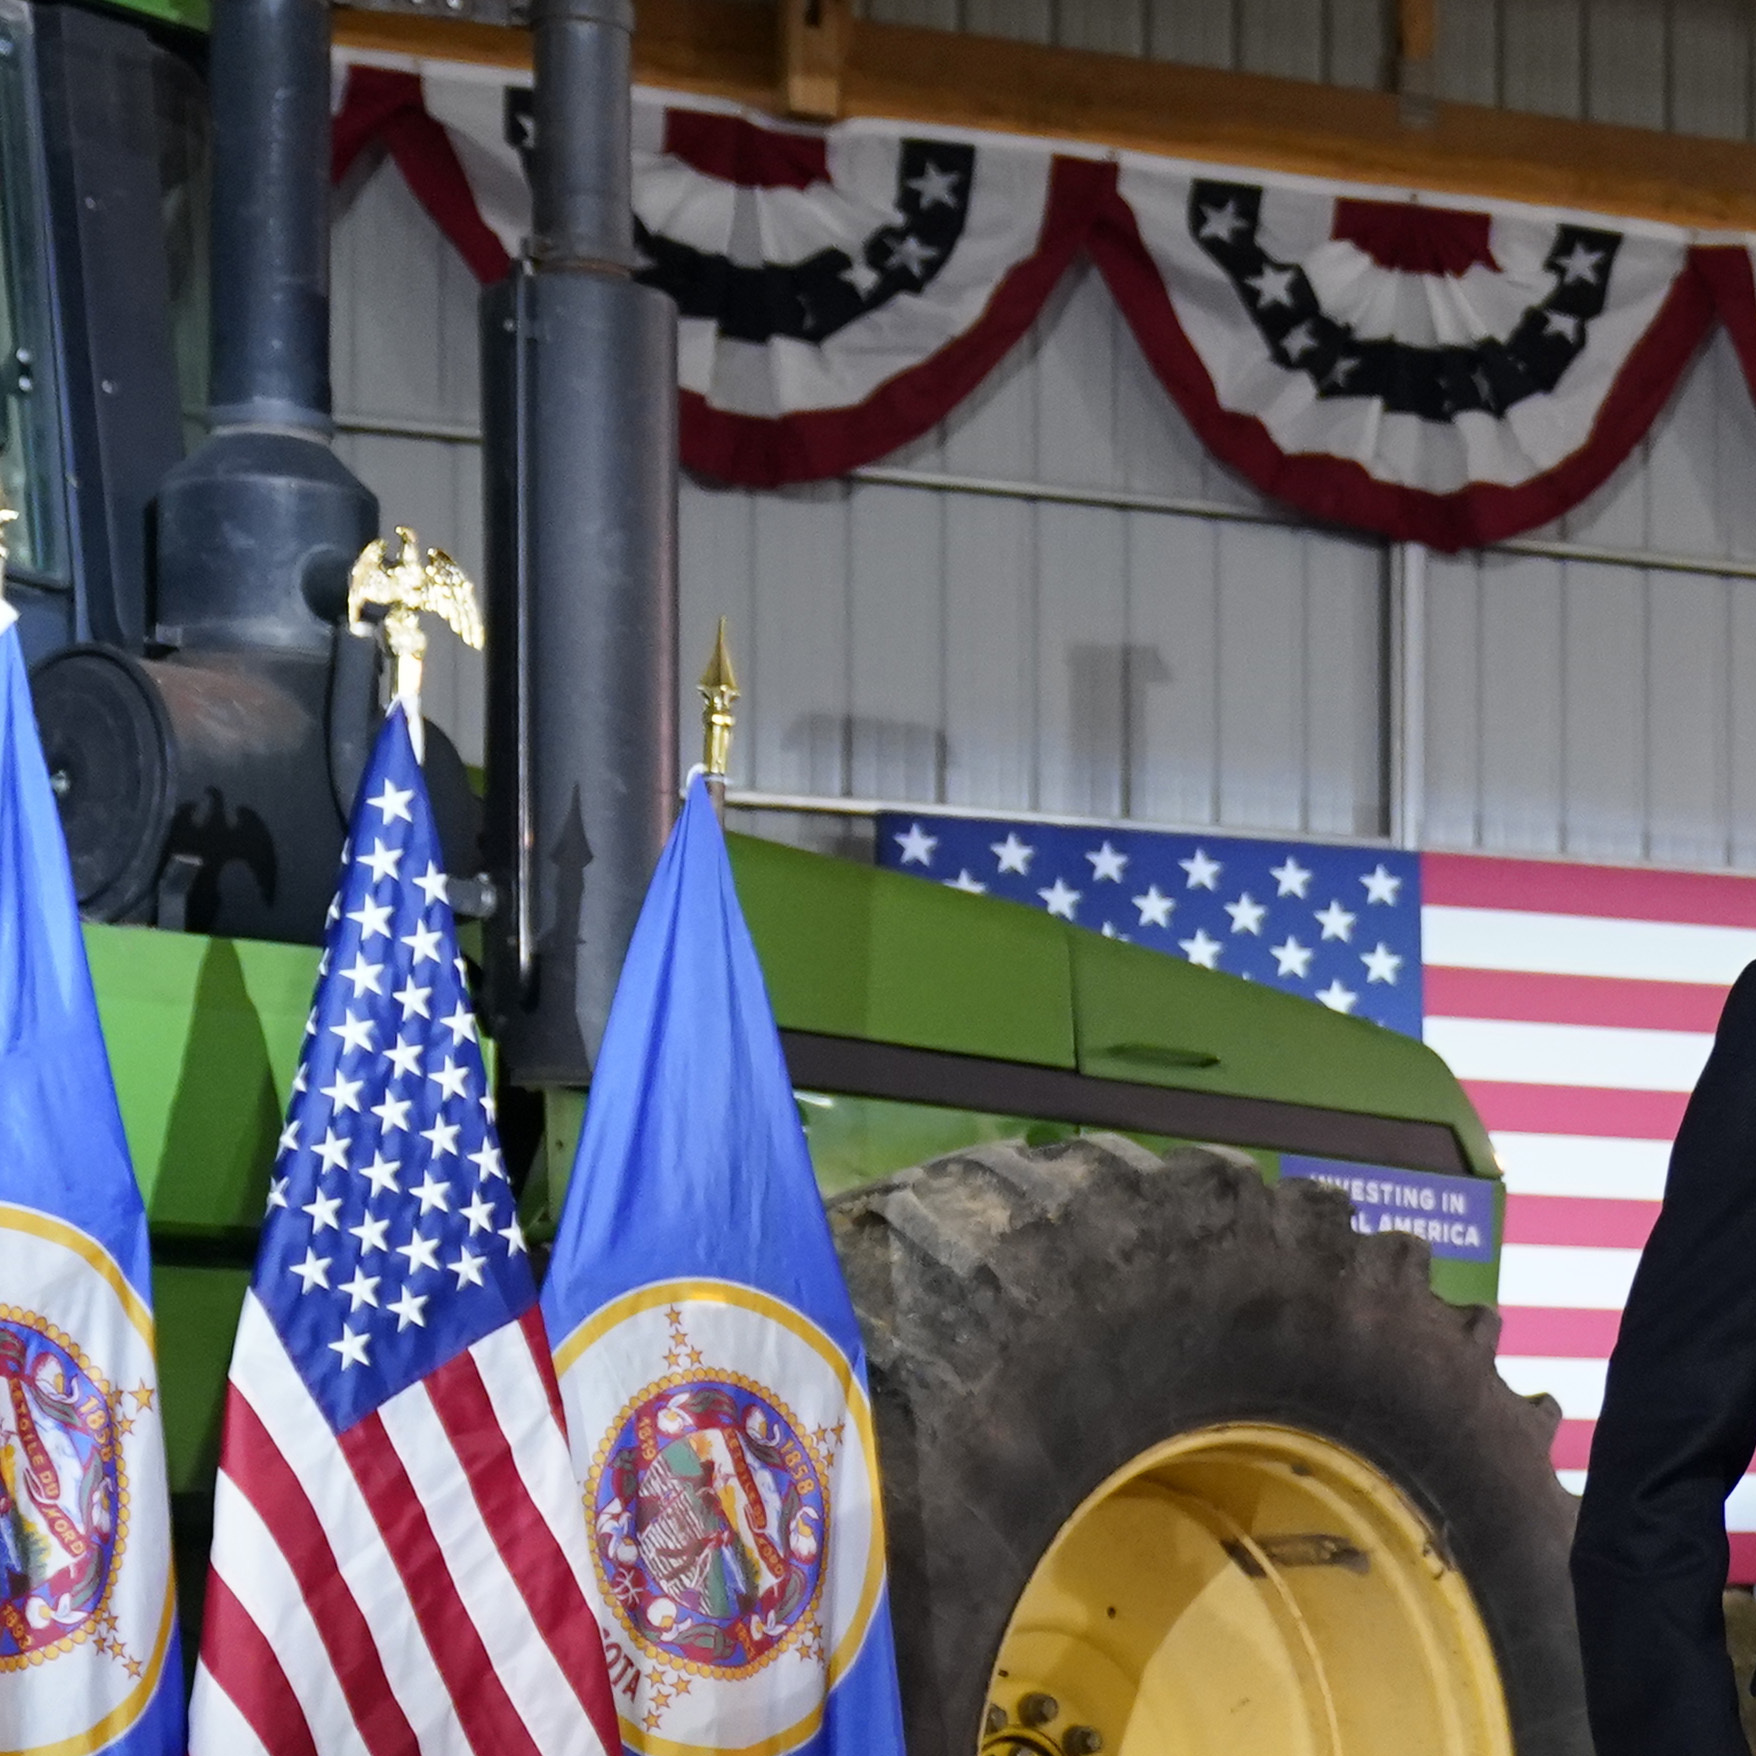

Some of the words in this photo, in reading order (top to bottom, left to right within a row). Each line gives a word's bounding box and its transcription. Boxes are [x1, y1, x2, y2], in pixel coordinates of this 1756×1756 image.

[1442, 1192, 1466, 1215] IN
[1378, 1213, 1480, 1247] AMERICA
[780, 1439, 815, 1495] 1858
